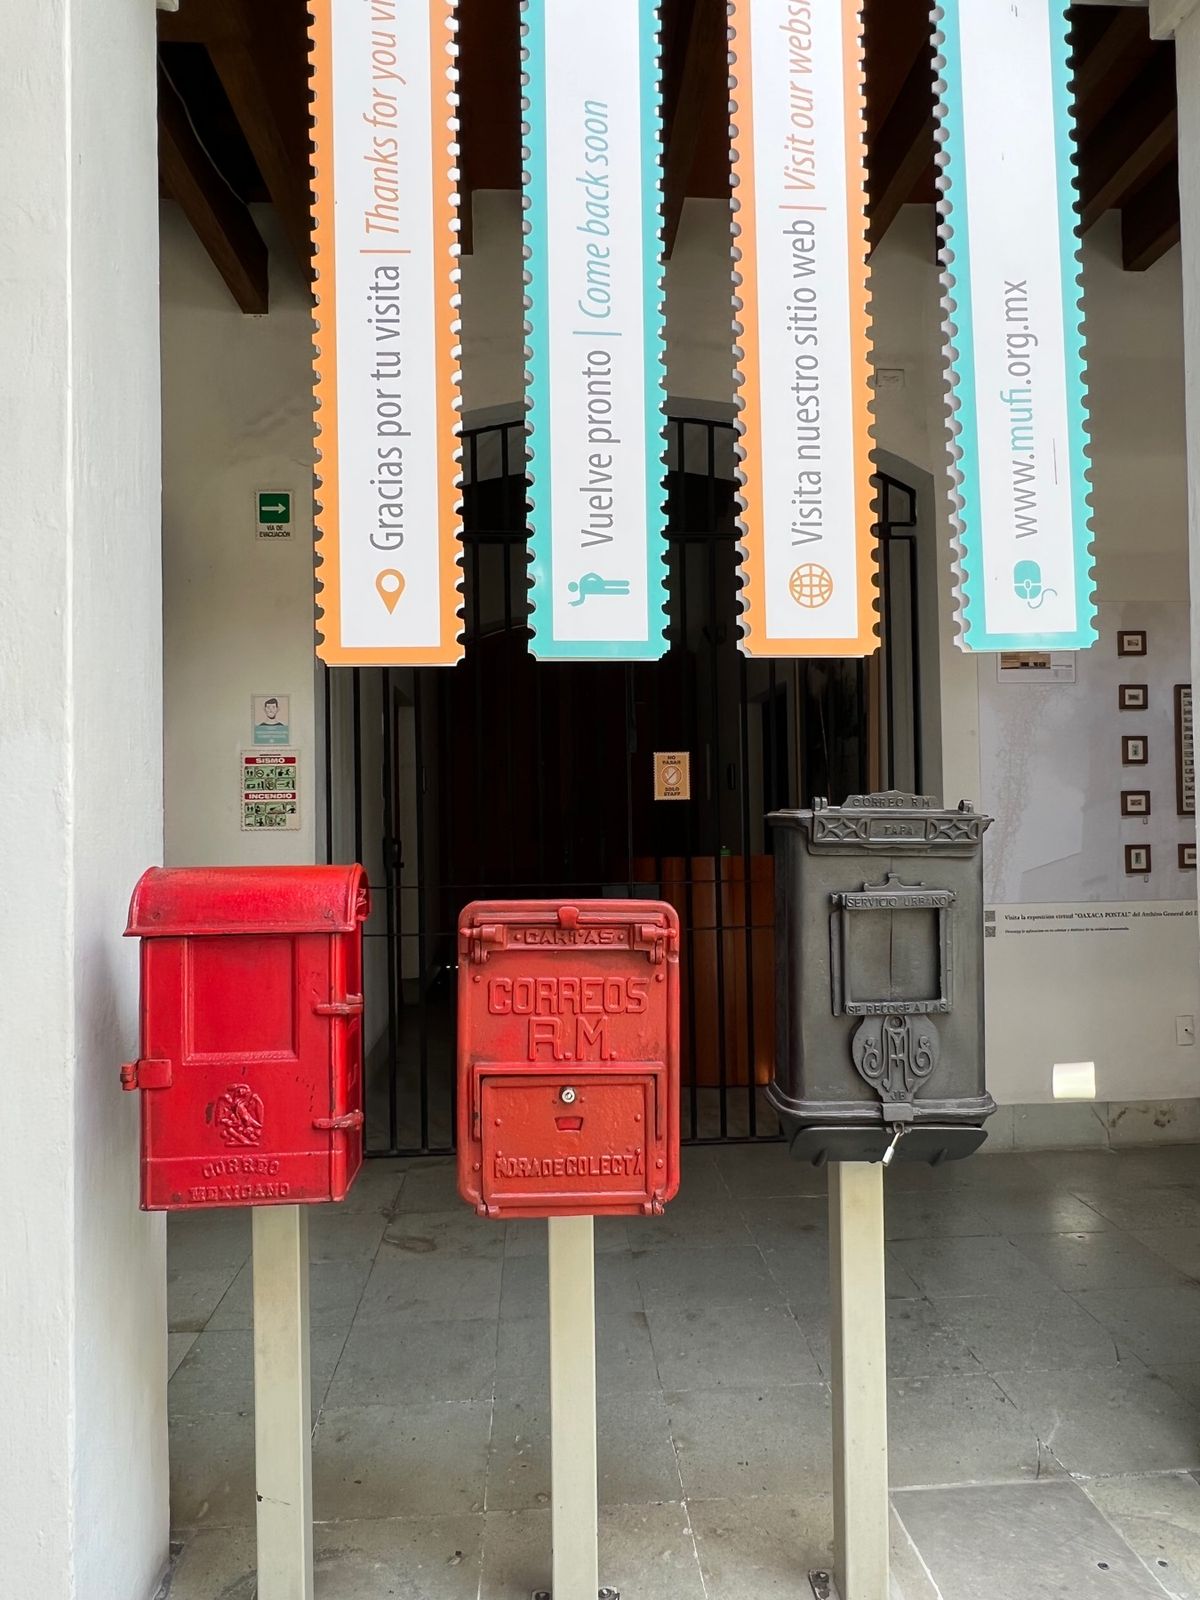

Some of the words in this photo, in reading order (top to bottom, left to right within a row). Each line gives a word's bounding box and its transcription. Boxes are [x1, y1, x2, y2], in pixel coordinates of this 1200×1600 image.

[371, 30, 407, 86] you
[362, 87, 398, 129] for
[583, 99, 609, 167] soon
[789, 80, 814, 129] our
[363, 135, 400, 234] Thanks
[783, 133, 816, 190] Visit
[575, 171, 610, 237] back
[782, 219, 817, 279] web
[366, 265, 401, 342] visita
[577, 242, 612, 319] Come
[786, 287, 819, 347] sitio
[369, 351, 402, 382] tu
[376, 388, 412, 437] por
[581, 350, 622, 444] pronto
[790, 354, 821, 461] nuestro
[999, 279, 1039, 540] www.mufi.org.mx
[369, 447, 404, 551] Gracias
[579, 453, 614, 549] Vuelve
[791, 470, 823, 547] Visita
[852, 796, 904, 807] CORREO
[883, 824, 914, 836] TAPA
[846, 897, 898, 908] SERVICIO
[523, 929, 616, 945] CARTAS
[487, 976, 650, 1015] CORREOS
[847, 1004, 861, 1014] SE
[190, 1183, 291, 1201] MEXICANO
[202, 1158, 281, 1179] CORREO
